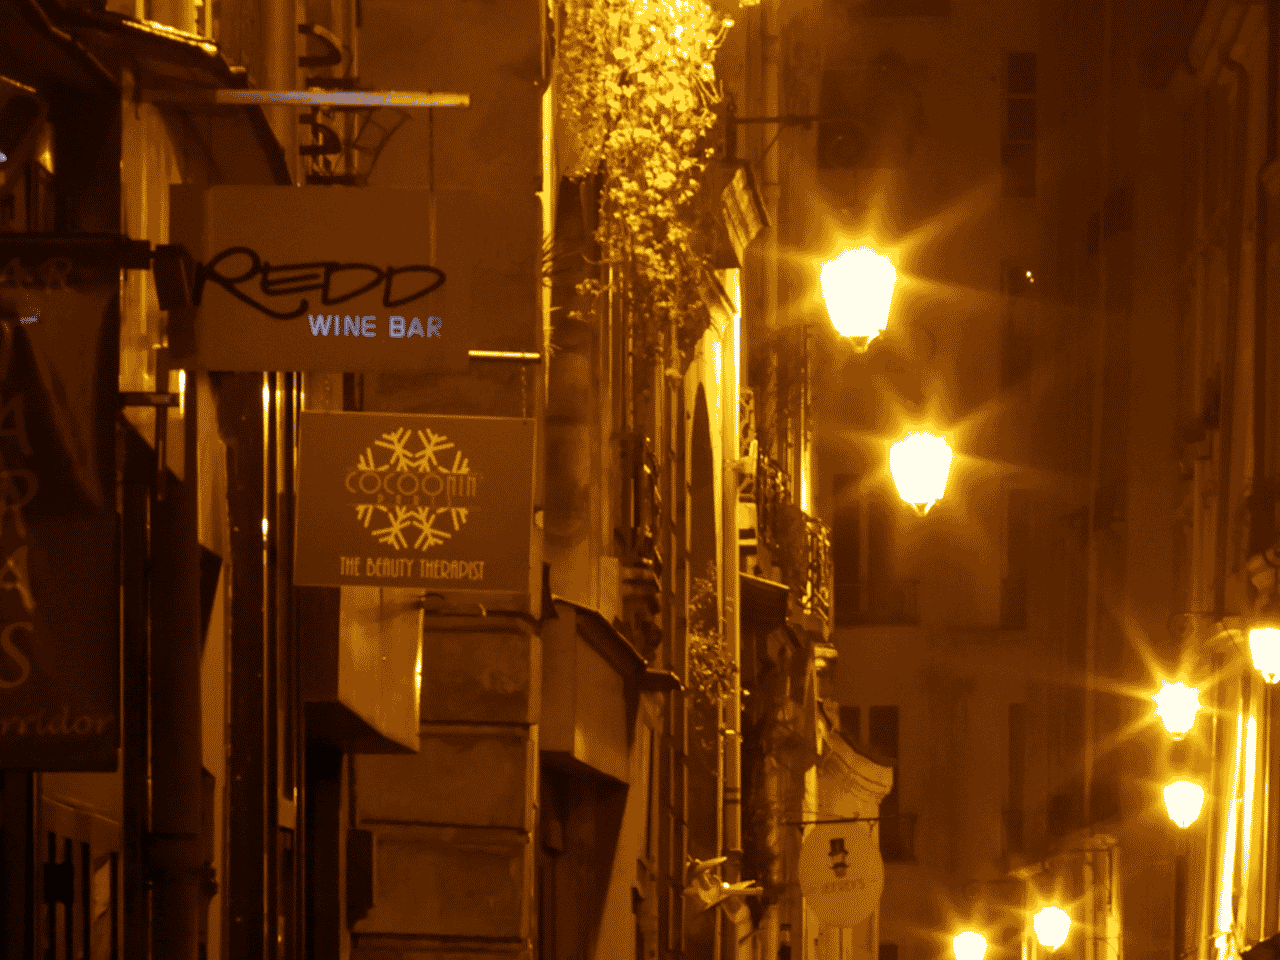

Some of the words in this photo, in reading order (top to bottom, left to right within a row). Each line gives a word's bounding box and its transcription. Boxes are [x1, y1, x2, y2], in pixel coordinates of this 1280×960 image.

[193, 246, 447, 320] REDD
[308, 314, 377, 338] WINE
[388, 315, 443, 339] BAR
[344, 471, 478, 498] COCOONIN
[339, 555, 361, 577] THE
[365, 557, 414, 579] BEAUTY
[419, 558, 485, 581] THERAPIST
